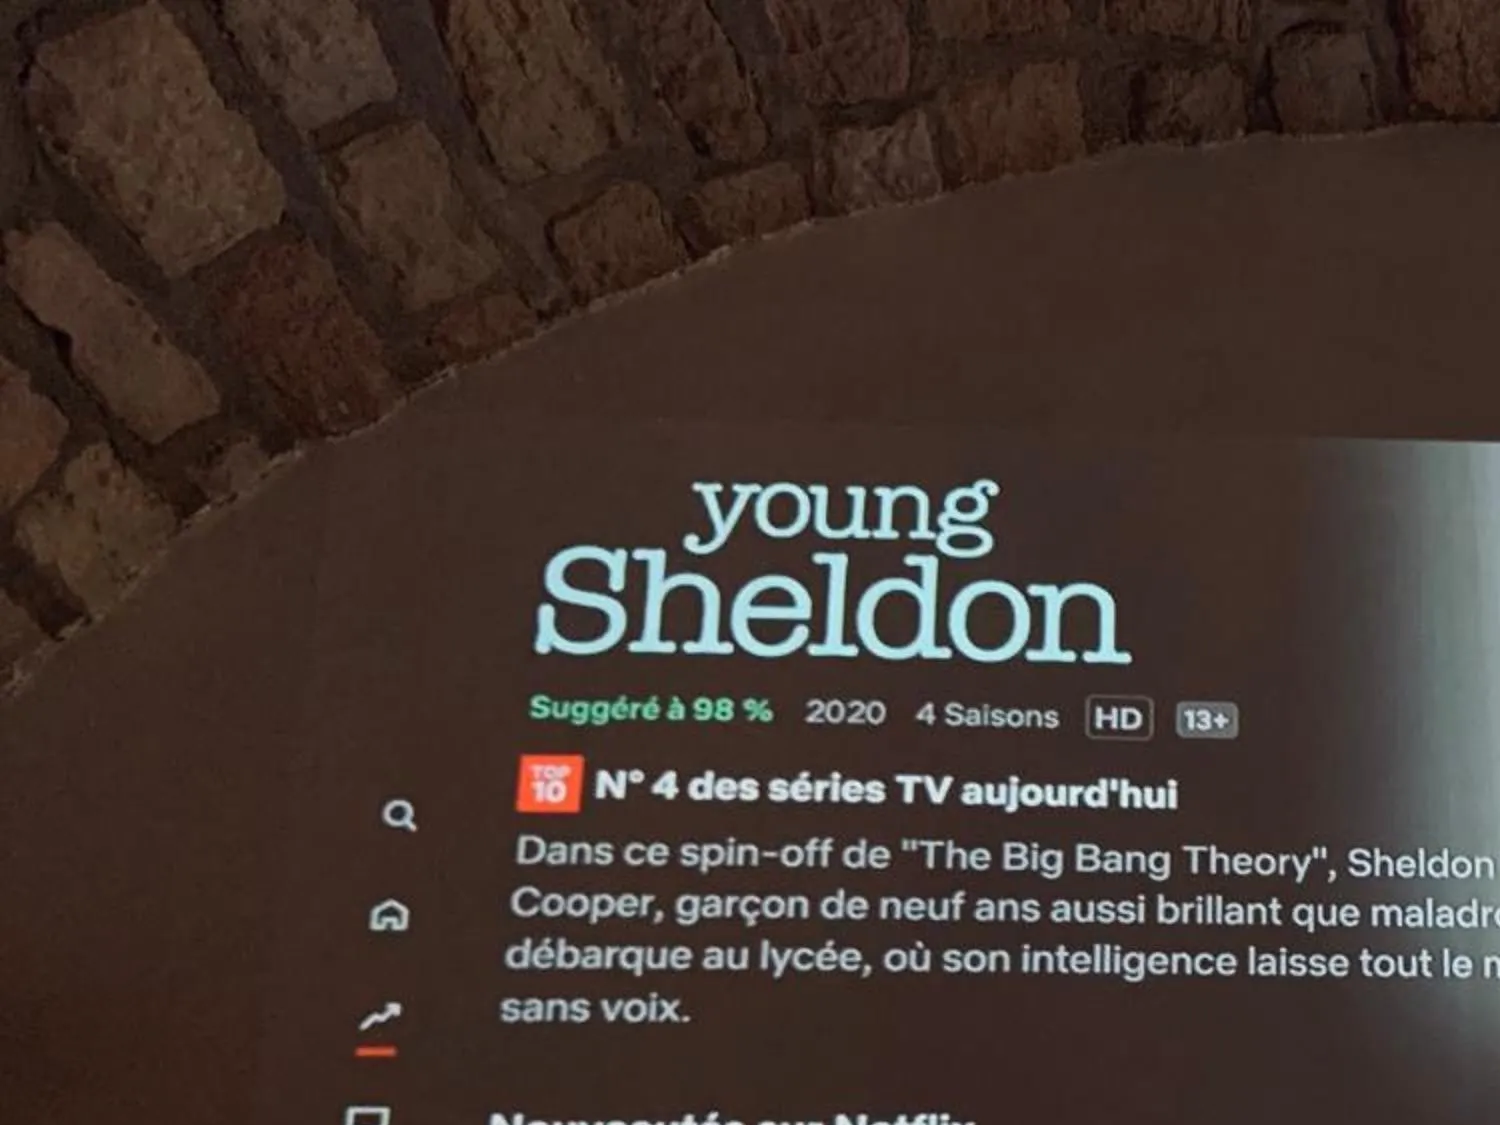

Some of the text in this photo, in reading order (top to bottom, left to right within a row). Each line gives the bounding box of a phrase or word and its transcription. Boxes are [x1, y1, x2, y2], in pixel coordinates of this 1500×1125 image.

[684, 479, 999, 559] young
[534, 545, 1132, 665] Sheldon
[529, 694, 774, 727] Suggéré à 98 %
[805, 699, 888, 726] 2020
[915, 702, 1060, 731] 4 Saisons
[1094, 706, 1143, 732] HD
[1183, 707, 1231, 733] 13+
[530, 763, 572, 781] TOP
[530, 780, 568, 804] 10
[595, 769, 1179, 813] N° 4 des séries TV aujourd'hui
[515, 834, 1496, 884] Dans ce spin-off de "The Big Bang Theory", Sheldon
[509, 885, 665, 925] Cooper,
[675, 894, 808, 927] garçon
[820, 889, 869, 921] de
[879, 890, 965, 923] neuf
[974, 899, 1041, 924] ans
[1050, 894, 1146, 925] aussi
[1157, 895, 1282, 927] brillant
[1292, 904, 1361, 933] que
[504, 938, 693, 976] débarque
[703, 946, 749, 971] au
[760, 939, 872, 979] lycée,
[883, 941, 932, 974] où
[942, 949, 1011, 975] son
[1022, 943, 1238, 983] intelligence
[1248, 946, 1350, 978] laisse
[1361, 949, 1434, 979] tout
[1443, 948, 1473, 980] le
[500, 993, 691, 1023] sans voix.
